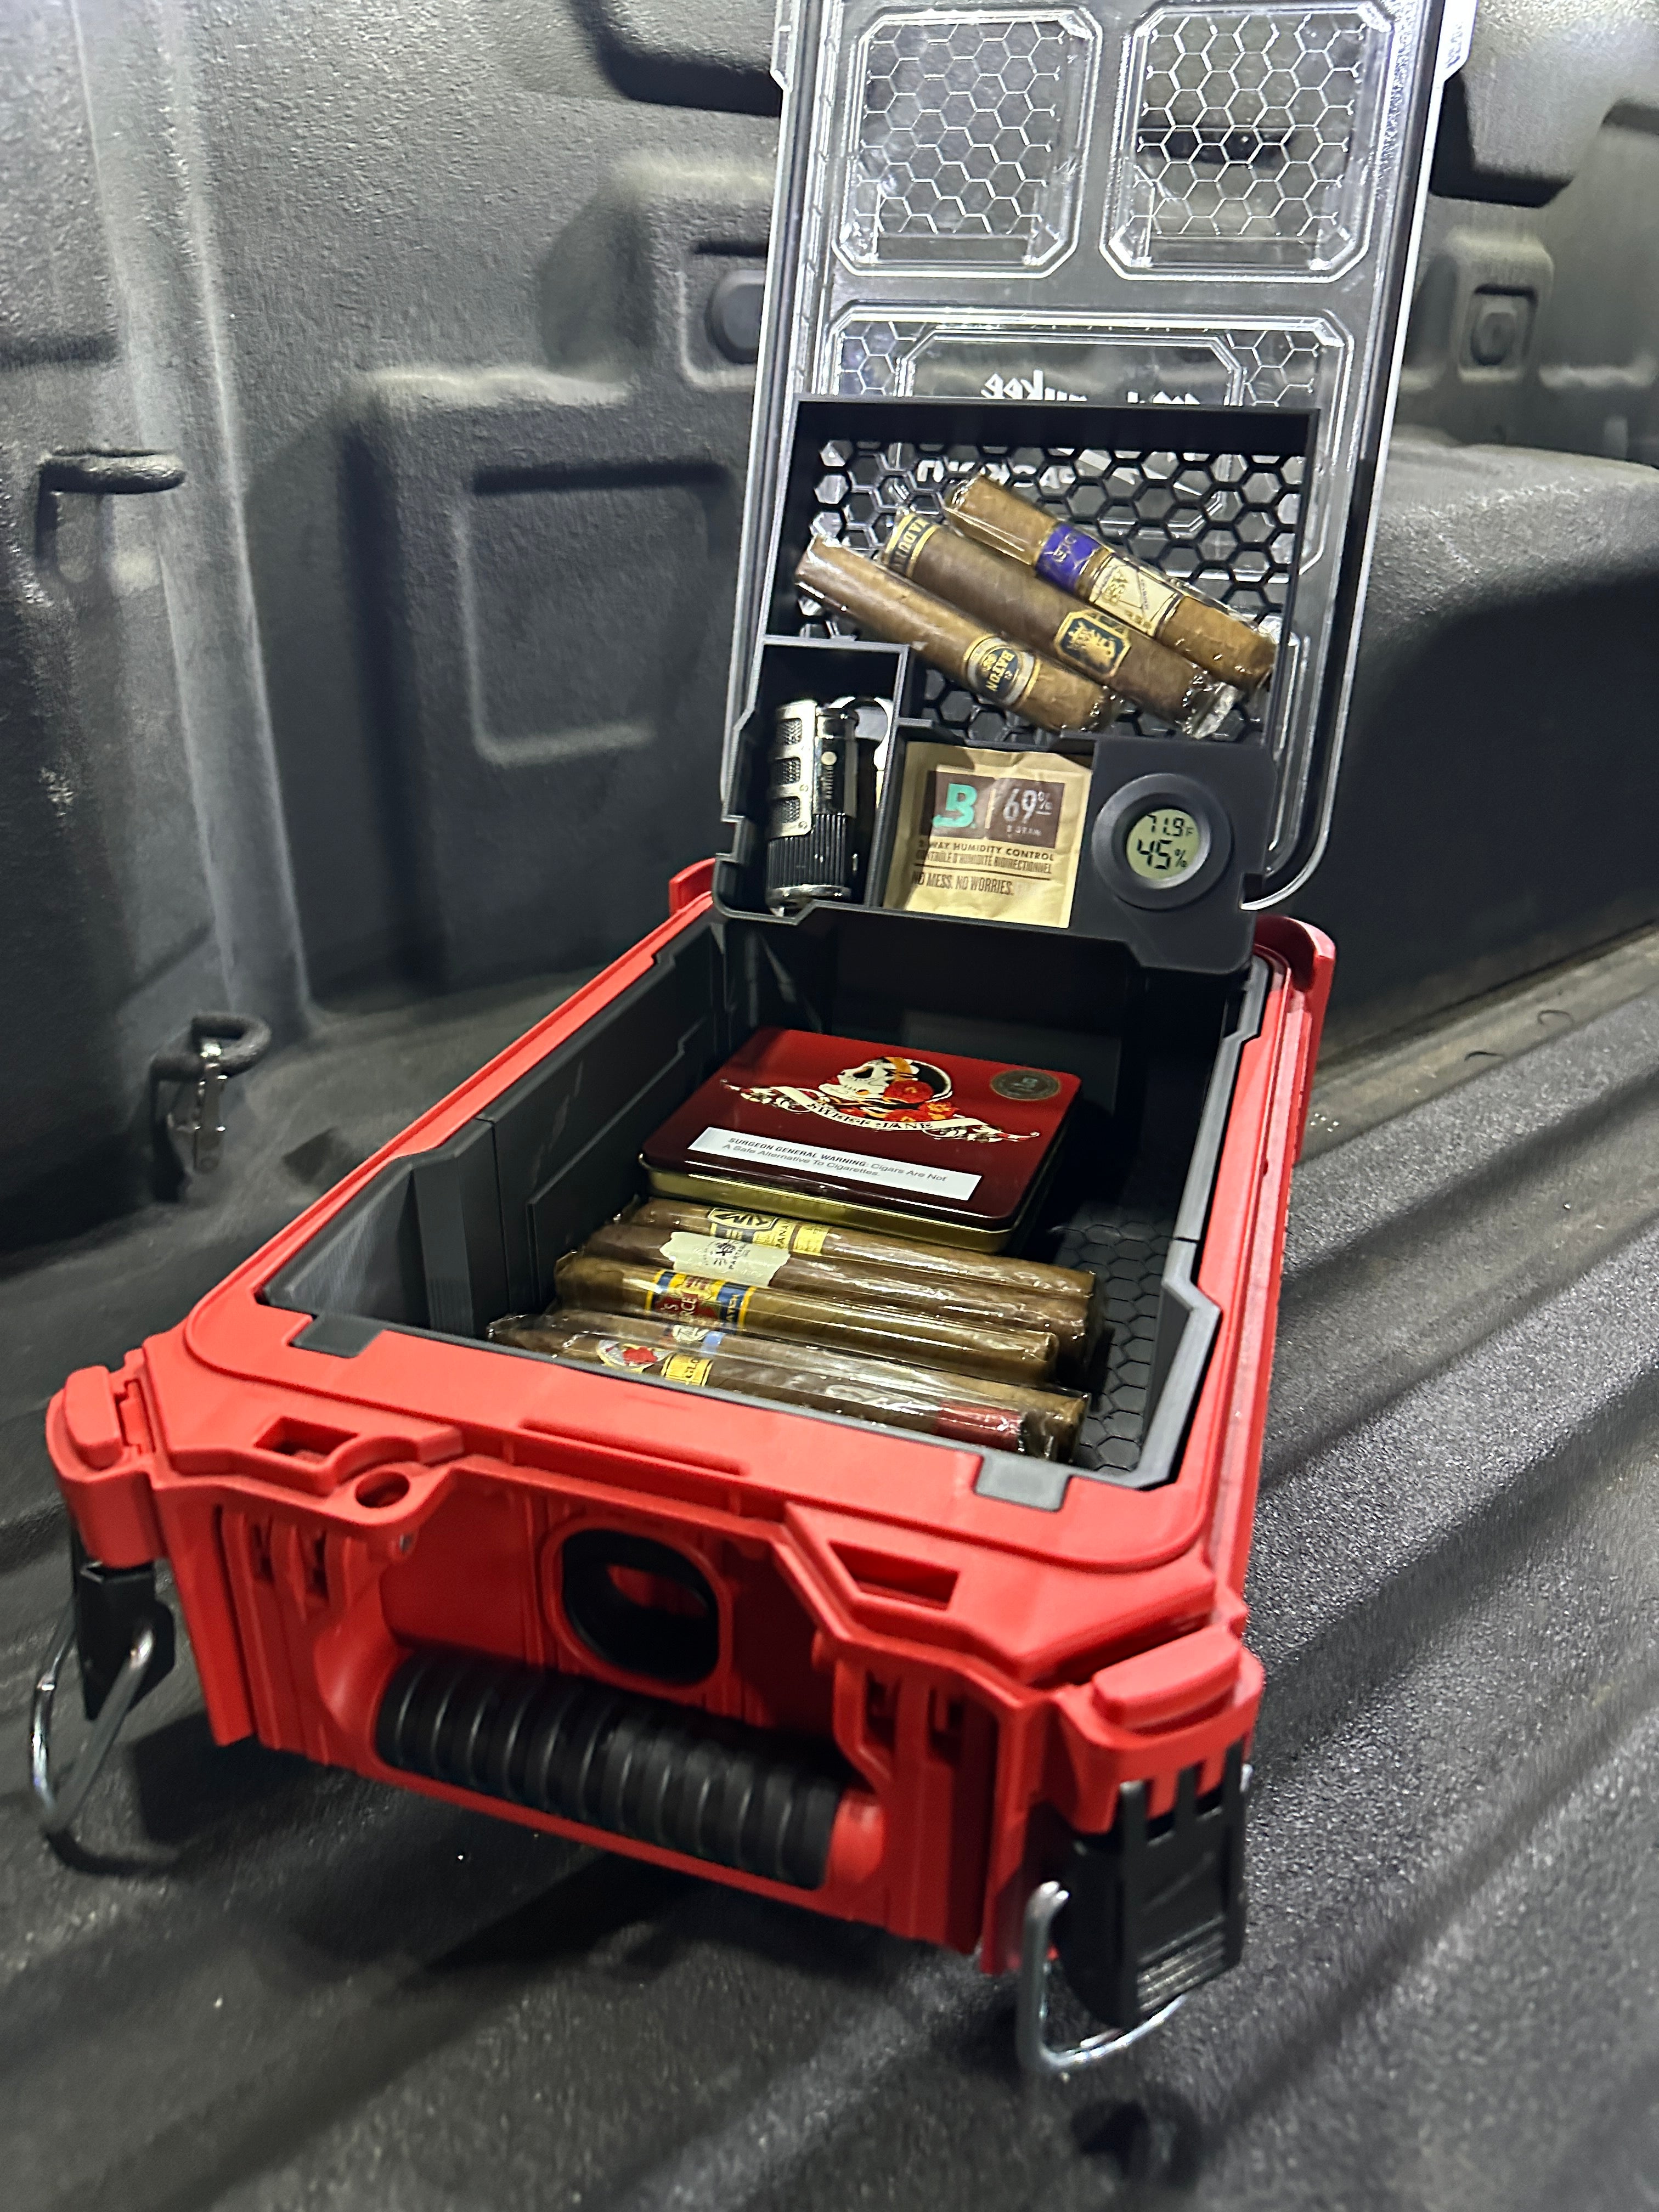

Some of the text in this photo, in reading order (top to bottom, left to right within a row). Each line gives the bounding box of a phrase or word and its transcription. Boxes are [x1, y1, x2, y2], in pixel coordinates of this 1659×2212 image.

[985, 650, 1015, 692] BATON
[953, 842, 1002, 854] HUMIDITY
[1006, 848, 1054, 861] CONTROL
[955, 875, 968, 890] NO
[728, 1138, 774, 1150] SURGEON
[776, 1147, 818, 1158] GENERAL
[821, 1154, 869, 1167] WARNING:
[871, 1163, 905, 1173] Cigars
[927, 1173, 948, 1182] Not
[757, 1150, 810, 1164] Alternative
